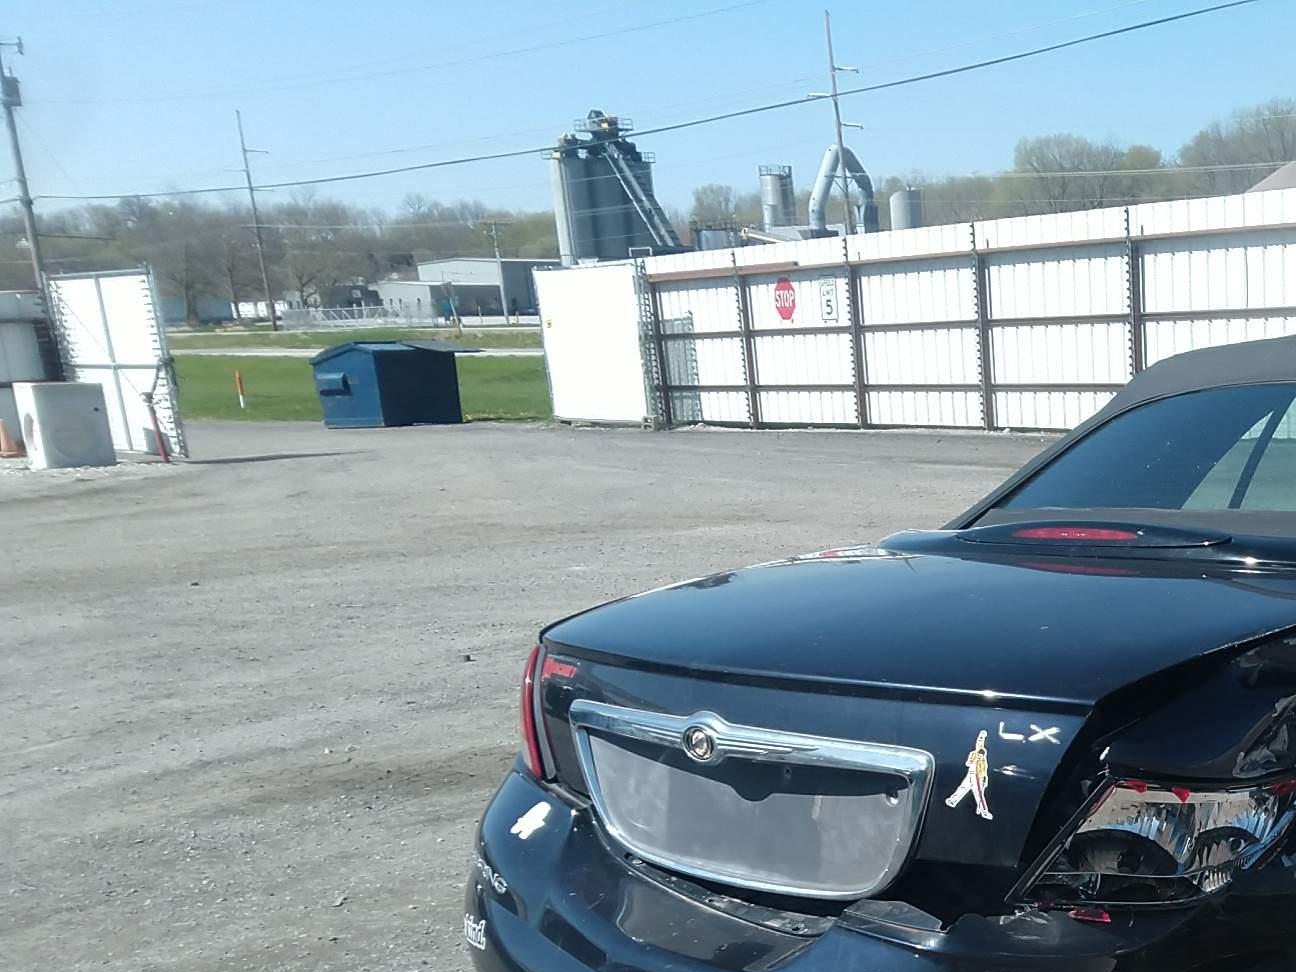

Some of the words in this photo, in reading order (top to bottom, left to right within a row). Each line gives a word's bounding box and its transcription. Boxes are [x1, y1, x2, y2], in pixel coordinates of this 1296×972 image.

[775, 290, 794, 308] STOP
[826, 299, 834, 315] 5
[999, 721, 1061, 744] LX
